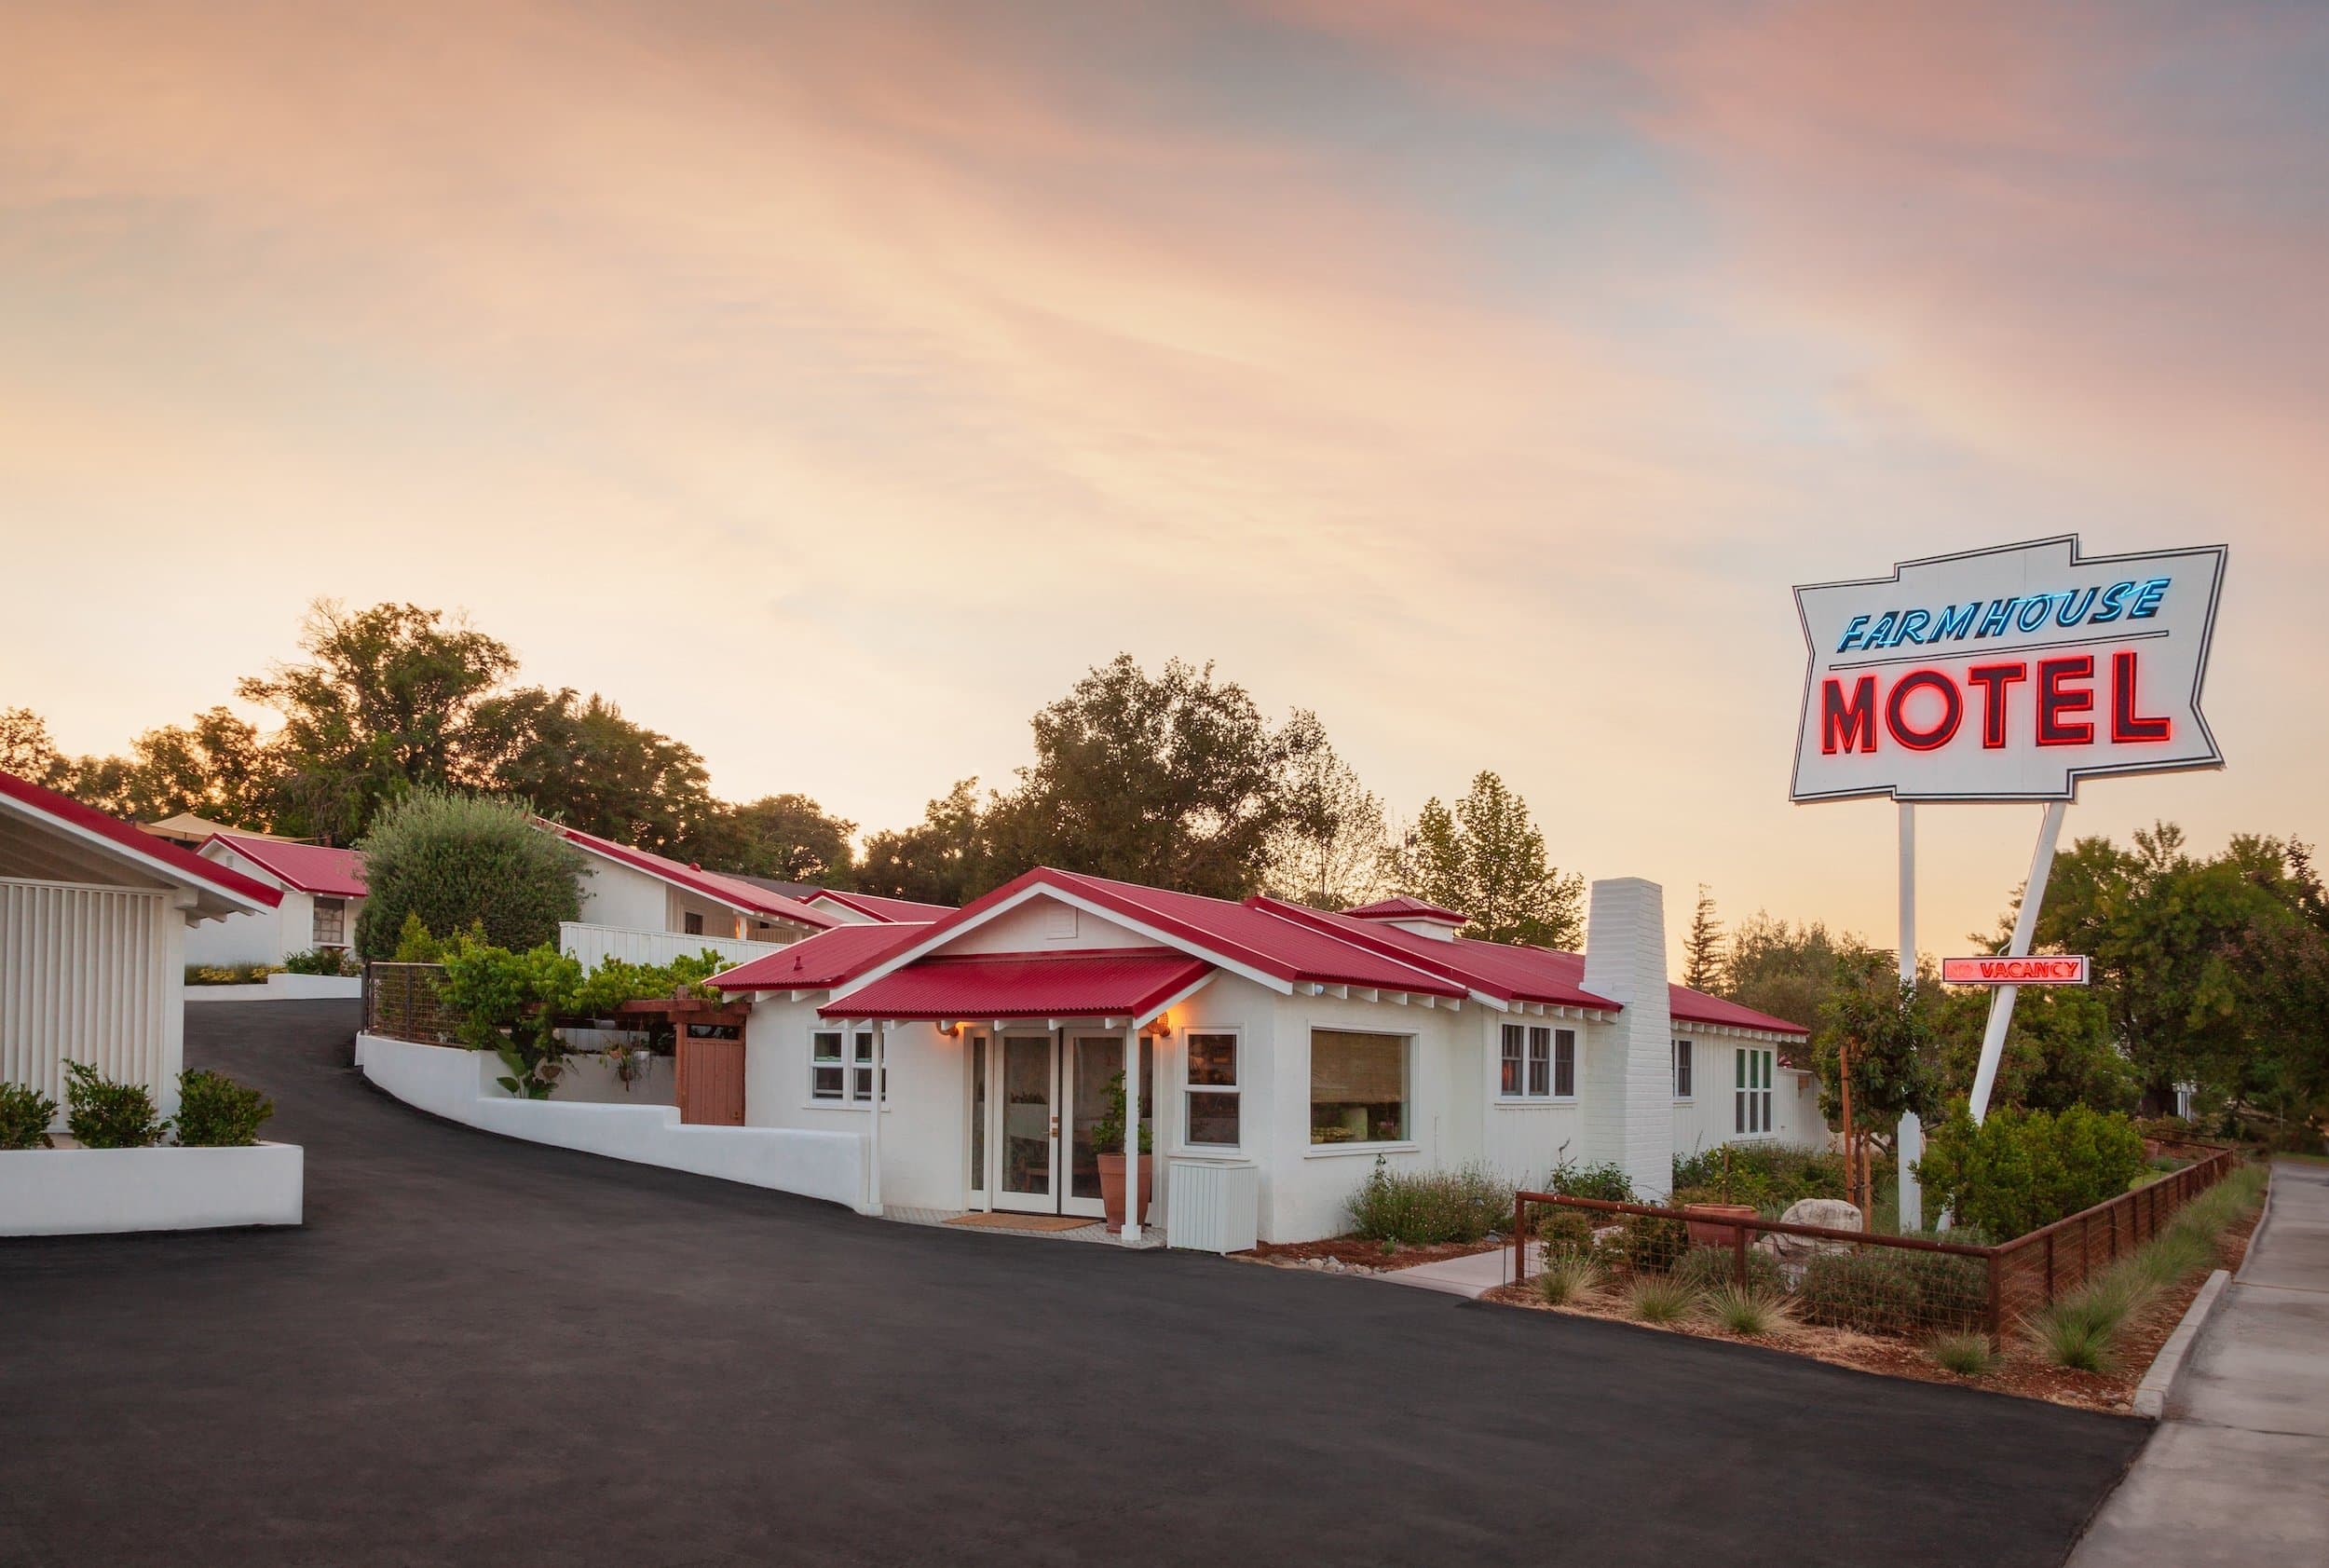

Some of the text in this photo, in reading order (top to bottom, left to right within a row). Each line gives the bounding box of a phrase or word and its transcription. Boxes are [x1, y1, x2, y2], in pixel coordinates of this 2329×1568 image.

[1836, 578, 2171, 653] FARMHOUSE
[1821, 651, 2172, 755] MOTEL
[1980, 961, 2079, 978] VACANCY
